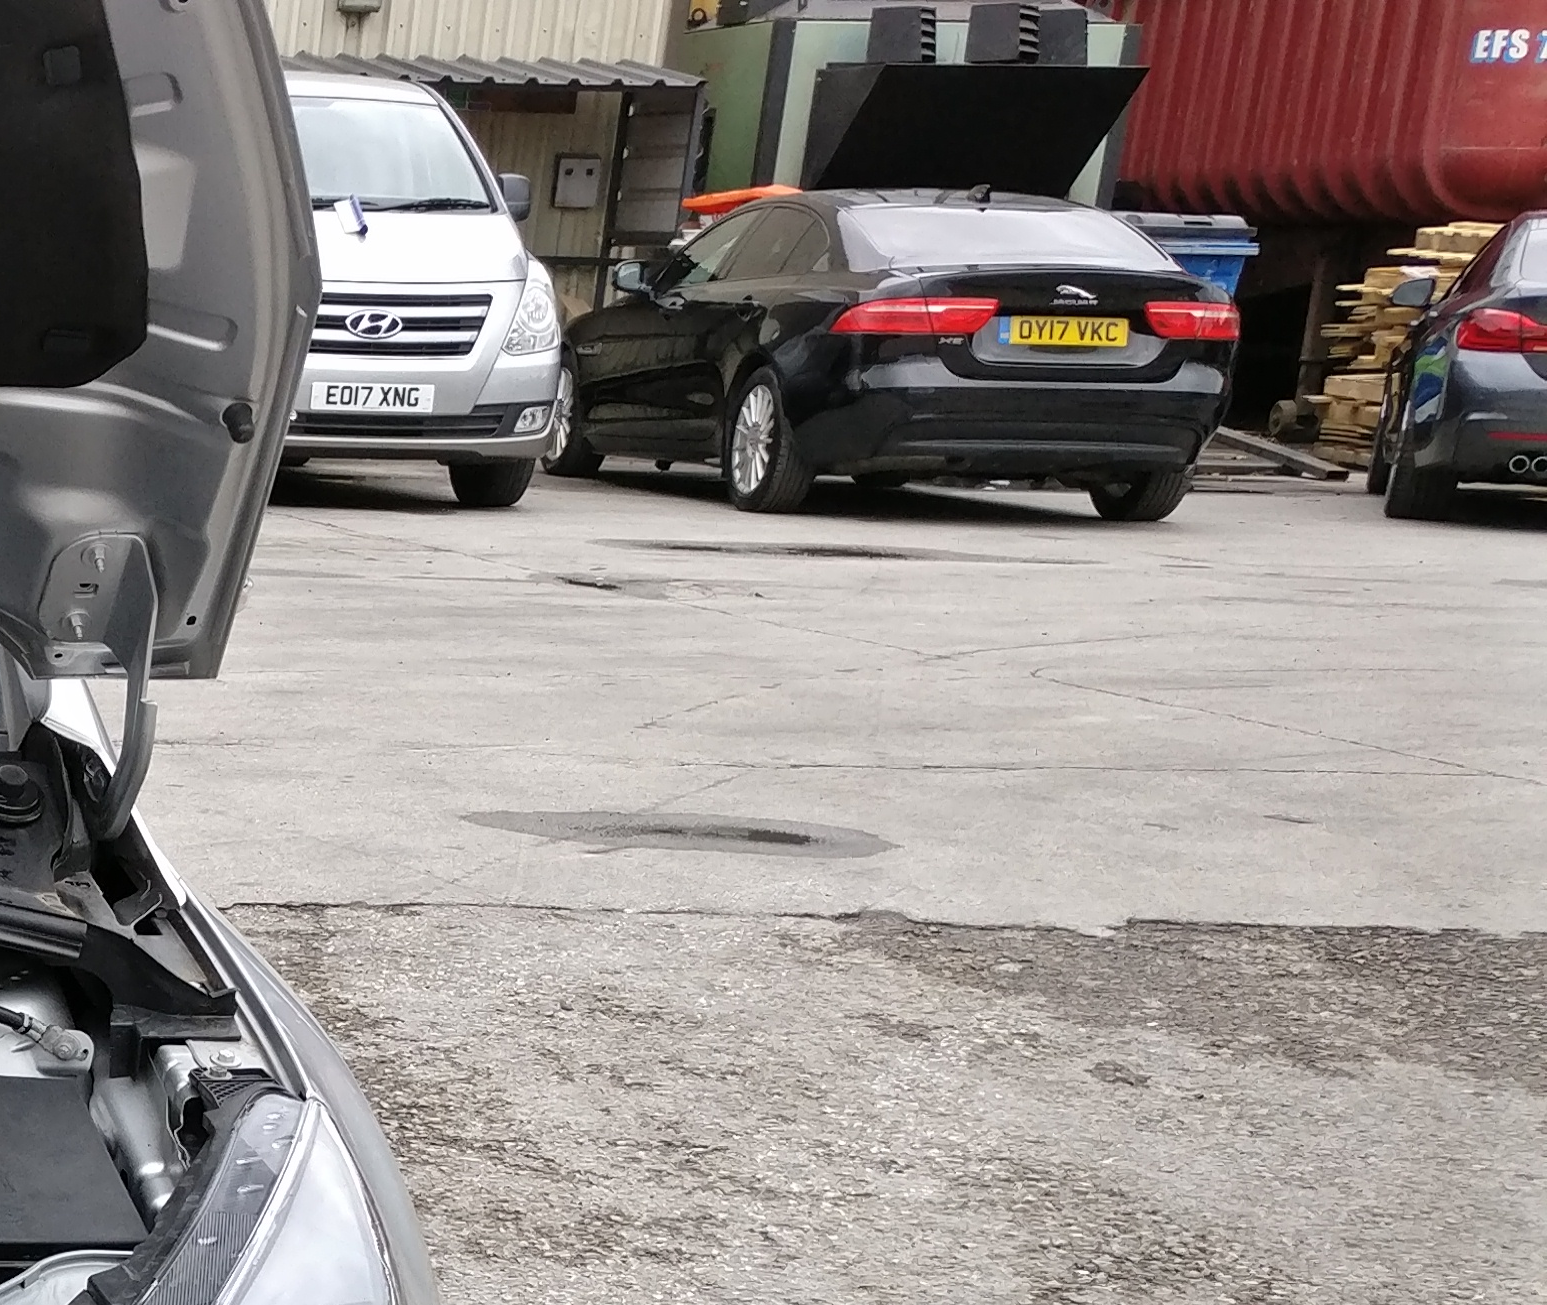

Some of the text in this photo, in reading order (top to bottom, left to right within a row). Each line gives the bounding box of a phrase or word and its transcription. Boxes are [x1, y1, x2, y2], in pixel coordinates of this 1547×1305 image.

[1470, 28, 1531, 63] EFS
[1077, 320, 1119, 342] VKC
[379, 386, 420, 407] XNG
